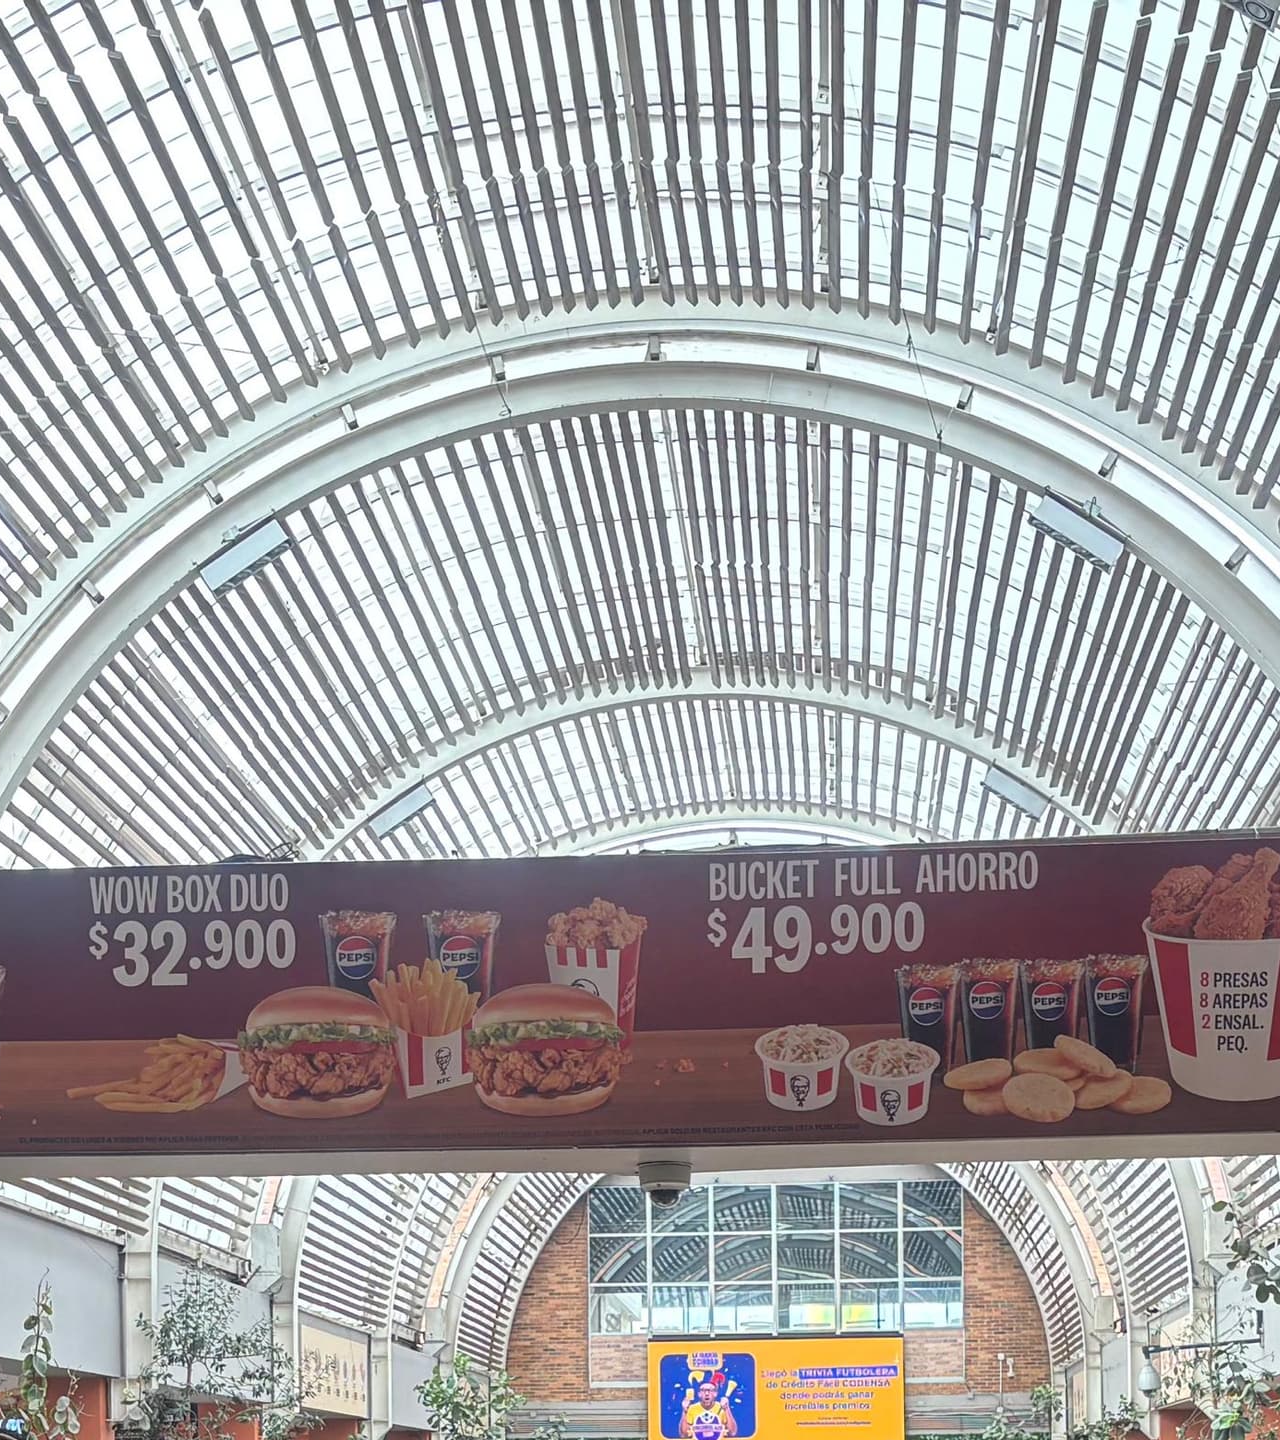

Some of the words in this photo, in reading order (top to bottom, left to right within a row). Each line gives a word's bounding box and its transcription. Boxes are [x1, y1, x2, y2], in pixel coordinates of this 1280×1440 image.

[710, 859, 819, 901] BUCKET
[835, 856, 901, 897] FULL
[918, 850, 1039, 894] AHORRO
[90, 875, 158, 915] WOW
[167, 874, 223, 913] BOX
[230, 873, 289, 912] DUO
[707, 902, 926, 974] $49.900
[89, 919, 297, 987] $32.900
[338, 952, 375, 962] PEPSI
[442, 952, 479, 962] PEPSI
[1200, 972, 1209, 989] 8
[1213, 970, 1269, 989] PRESAS
[971, 995, 1003, 1005] PEPSI
[1034, 996, 1065, 1006] PEPSI
[1097, 991, 1129, 1001] PEPSI
[1200, 993, 1209, 1009] 8
[1213, 991, 1269, 1010] AREPAS
[911, 1002, 943, 1011] PEPSI
[1201, 1013, 1210, 1030] 2
[1214, 1012, 1265, 1031] ENSAL.
[1217, 1034, 1249, 1054] PEQ.
[436, 1076, 451, 1085] KFC
[801, 1369, 834, 1377] TRIVIA
[836, 1367, 896, 1377] FUTBOLERA
[781, 1379, 815, 1388] Crédito
[842, 1379, 891, 1388] CODENSA
[780, 1390, 810, 1400] donde
[812, 1390, 845, 1401] podrás
[848, 1391, 875, 1401] ganar
[832, 1401, 870, 1411] premios
